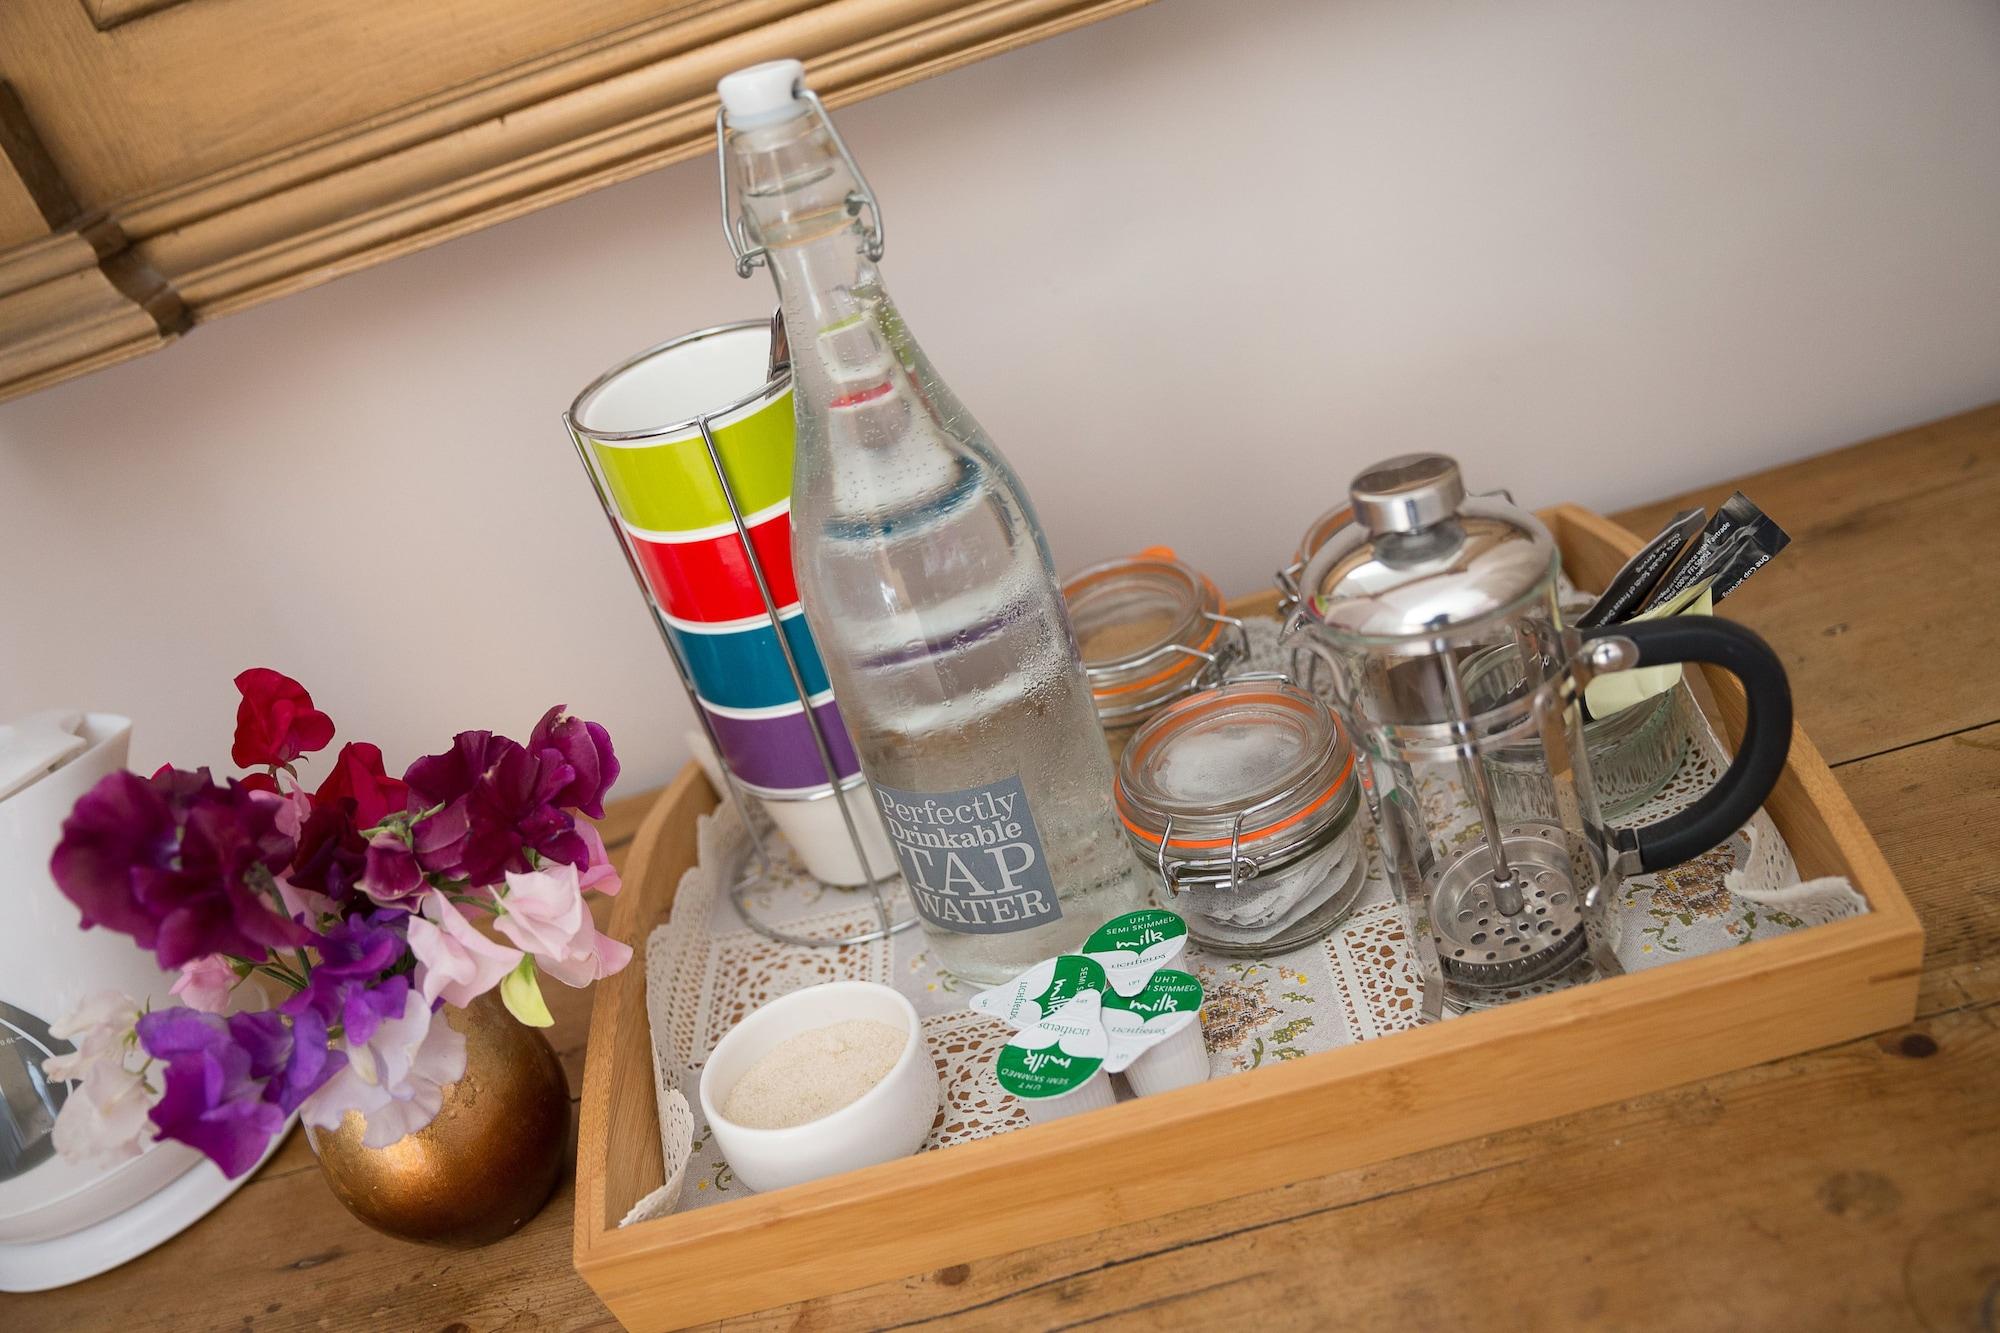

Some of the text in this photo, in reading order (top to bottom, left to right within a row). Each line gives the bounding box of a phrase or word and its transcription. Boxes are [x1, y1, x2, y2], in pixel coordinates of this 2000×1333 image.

[1695, 542, 1709, 555] with
[1706, 520, 1730, 544] Fairtrade
[1755, 555, 1769, 567] One
[1744, 567, 1757, 578] Cup
[876, 788, 1017, 825] Perfectly
[887, 821, 1022, 848] Drinkable
[896, 842, 1035, 896] TAP
[912, 885, 1050, 924] WATER
[1130, 914, 1152, 923] UHT
[1132, 916, 1175, 932] SKIMMED
[1116, 929, 1165, 949] milk
[1078, 967, 1089, 985] SEMI
[1155, 976, 1177, 984] UHT
[1129, 993, 1178, 1012] milk
[1023, 1050, 1072, 1073] milk
[1001, 1068, 1069, 1085] SEMI SKIMMED
[1018, 1082, 1042, 1091] UHT
